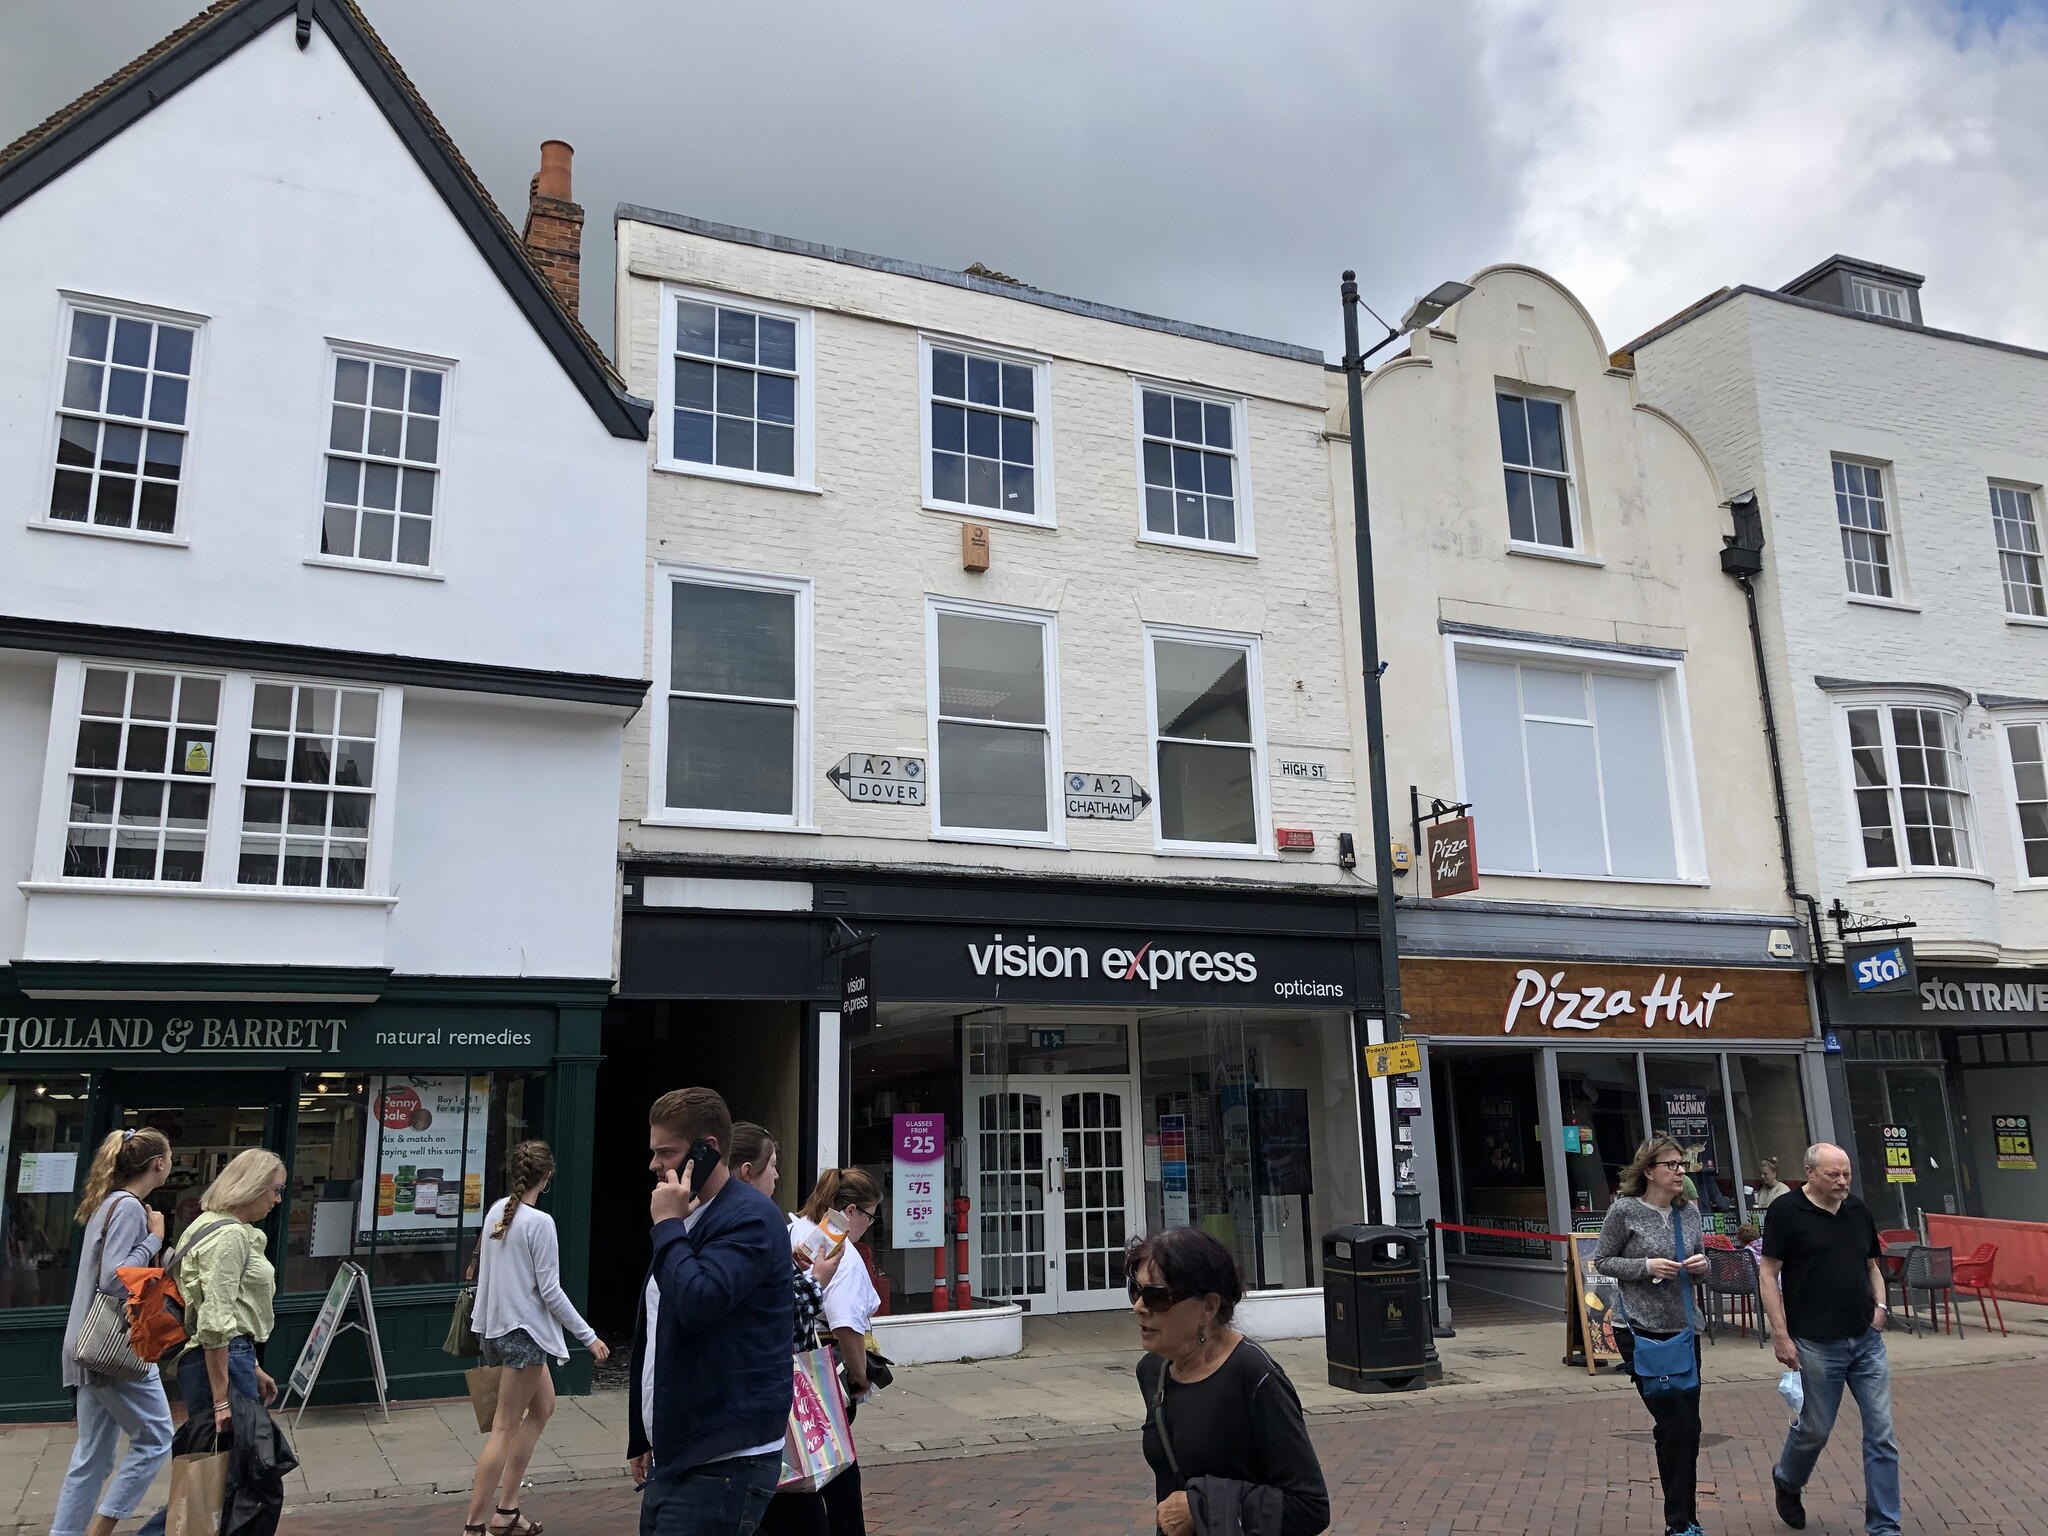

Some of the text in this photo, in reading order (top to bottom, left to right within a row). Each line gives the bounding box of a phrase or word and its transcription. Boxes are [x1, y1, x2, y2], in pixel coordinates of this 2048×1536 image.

[1282, 764, 1323, 777] HIGH ST
[859, 783, 918, 799] DOVER
[1070, 800, 1130, 815] CHATHAM
[1431, 838, 1468, 862] Pizza
[1437, 859, 1464, 880] Hut
[968, 934, 1258, 990] vision express
[1859, 956, 1900, 983] sta
[847, 976, 865, 994] vision
[1274, 980, 1344, 999] opticians
[1920, 976, 1965, 1011] sta
[1504, 969, 1734, 1034] Pizza Hut
[0, 1016, 347, 1054] HOLLAND & BARRETT
[376, 1028, 531, 1045] natural remedies
[1366, 1045, 1398, 1053] Pedestrian
[437, 1104, 448, 1112] for
[438, 1096, 452, 1106] Buy
[460, 1097, 473, 1105] gt
[1666, 1102, 1705, 1114] TAKEAWAY
[407, 1134, 432, 1142] match
[904, 1136, 935, 1153] £25
[381, 1148, 407, 1158] taying
[410, 1147, 425, 1155] well
[909, 1182, 930, 1194] £75
